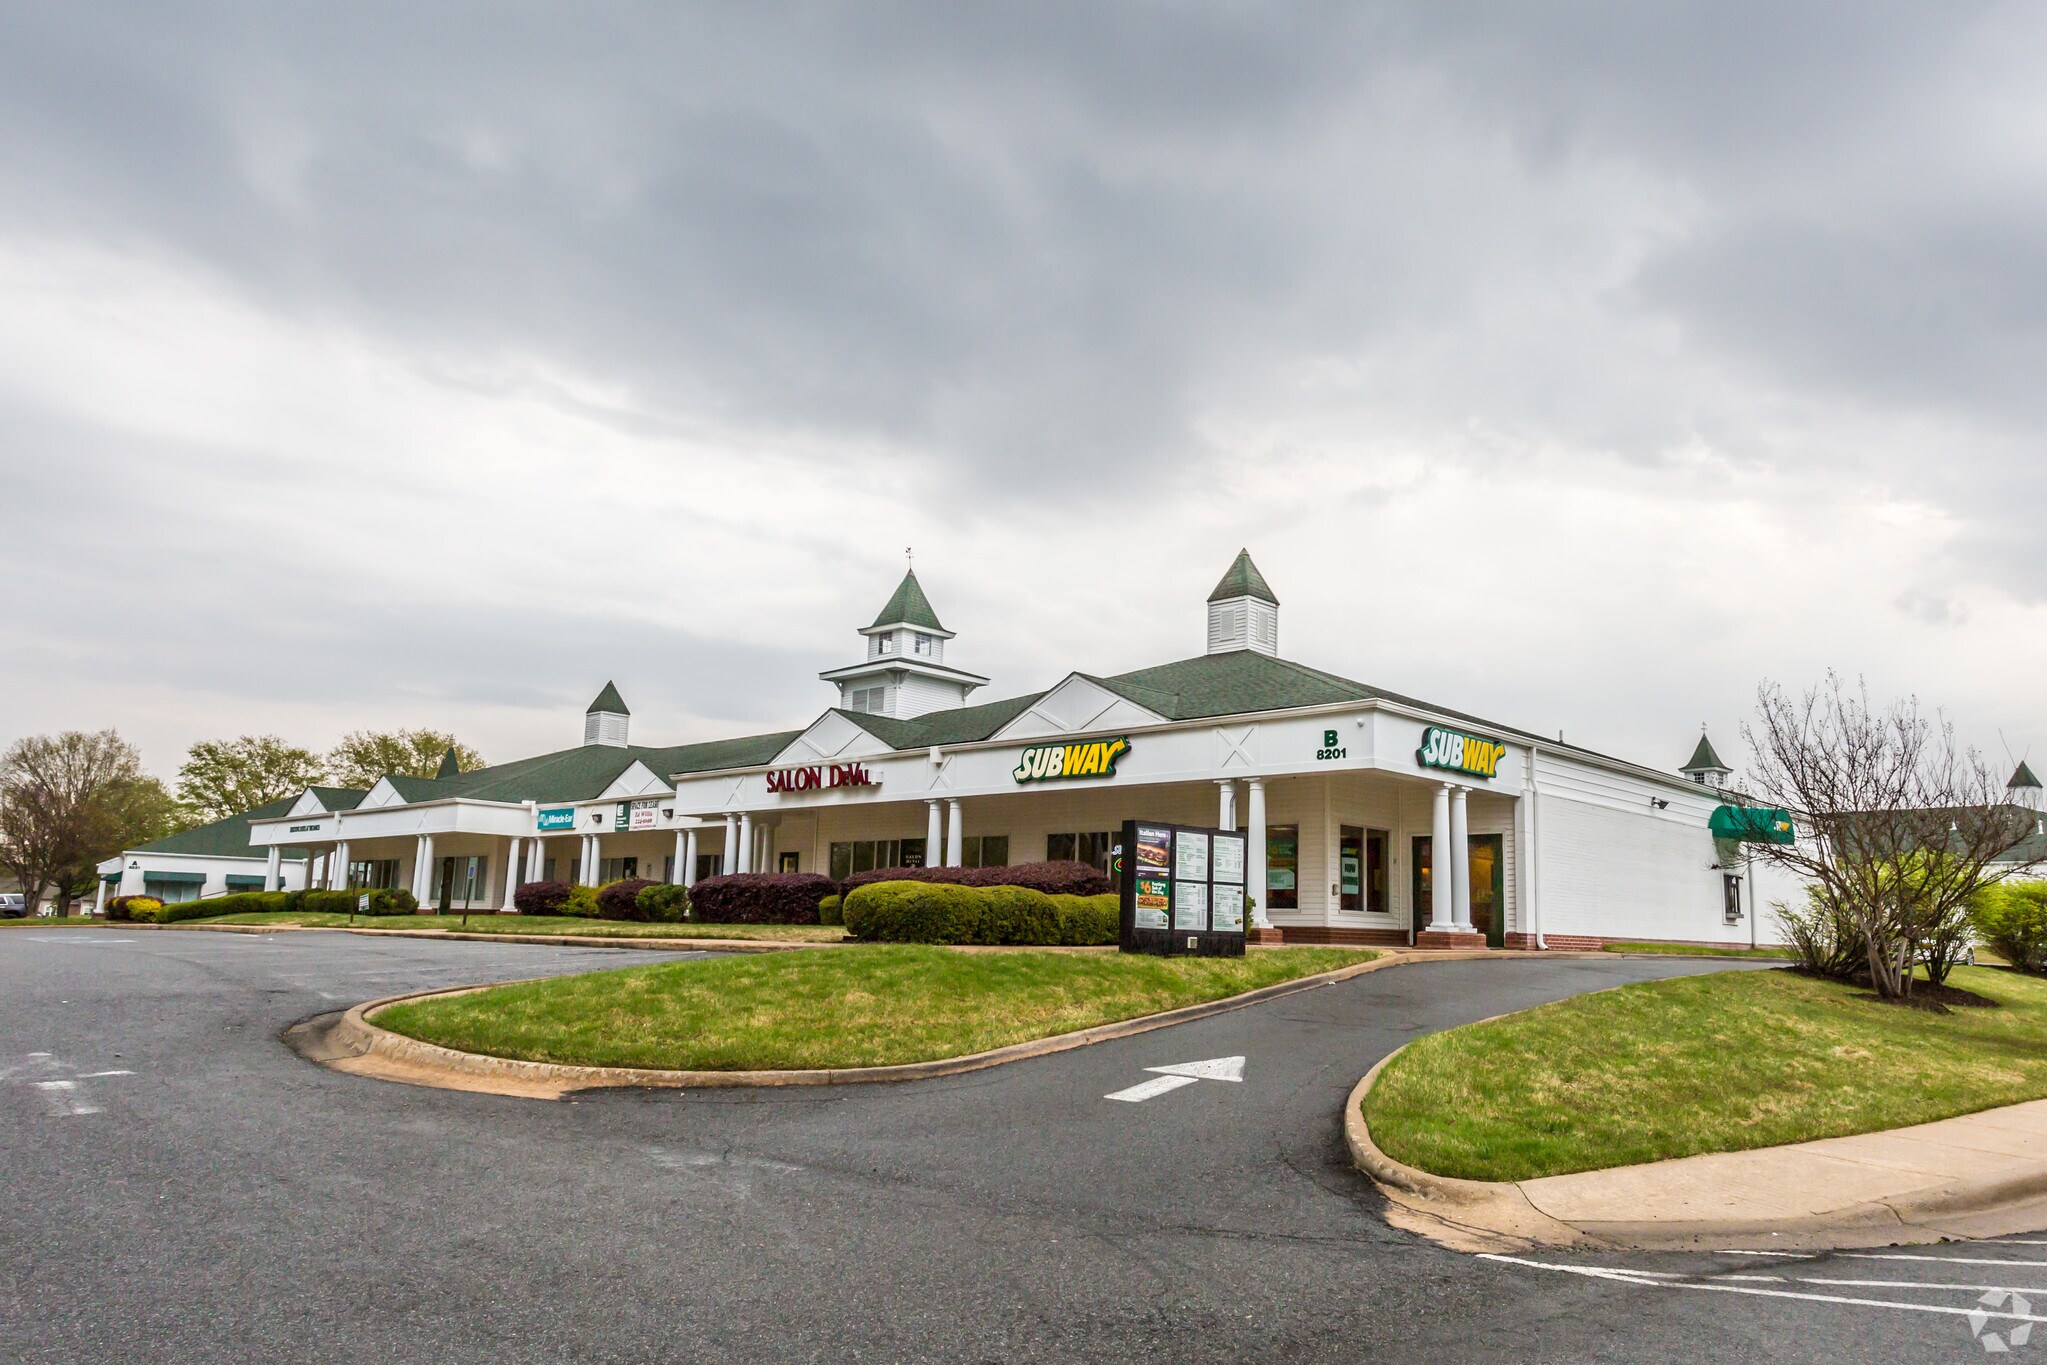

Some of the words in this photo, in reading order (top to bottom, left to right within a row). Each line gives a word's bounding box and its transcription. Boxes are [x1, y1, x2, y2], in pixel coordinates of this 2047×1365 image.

[1324, 730, 1338, 748] B
[1013, 738, 1126, 781] SUBWAY
[1316, 748, 1346, 760] 8201
[1423, 729, 1505, 775] SUBWAY
[766, 766, 822, 793] SALON
[1140, 880, 1152, 894] $6
